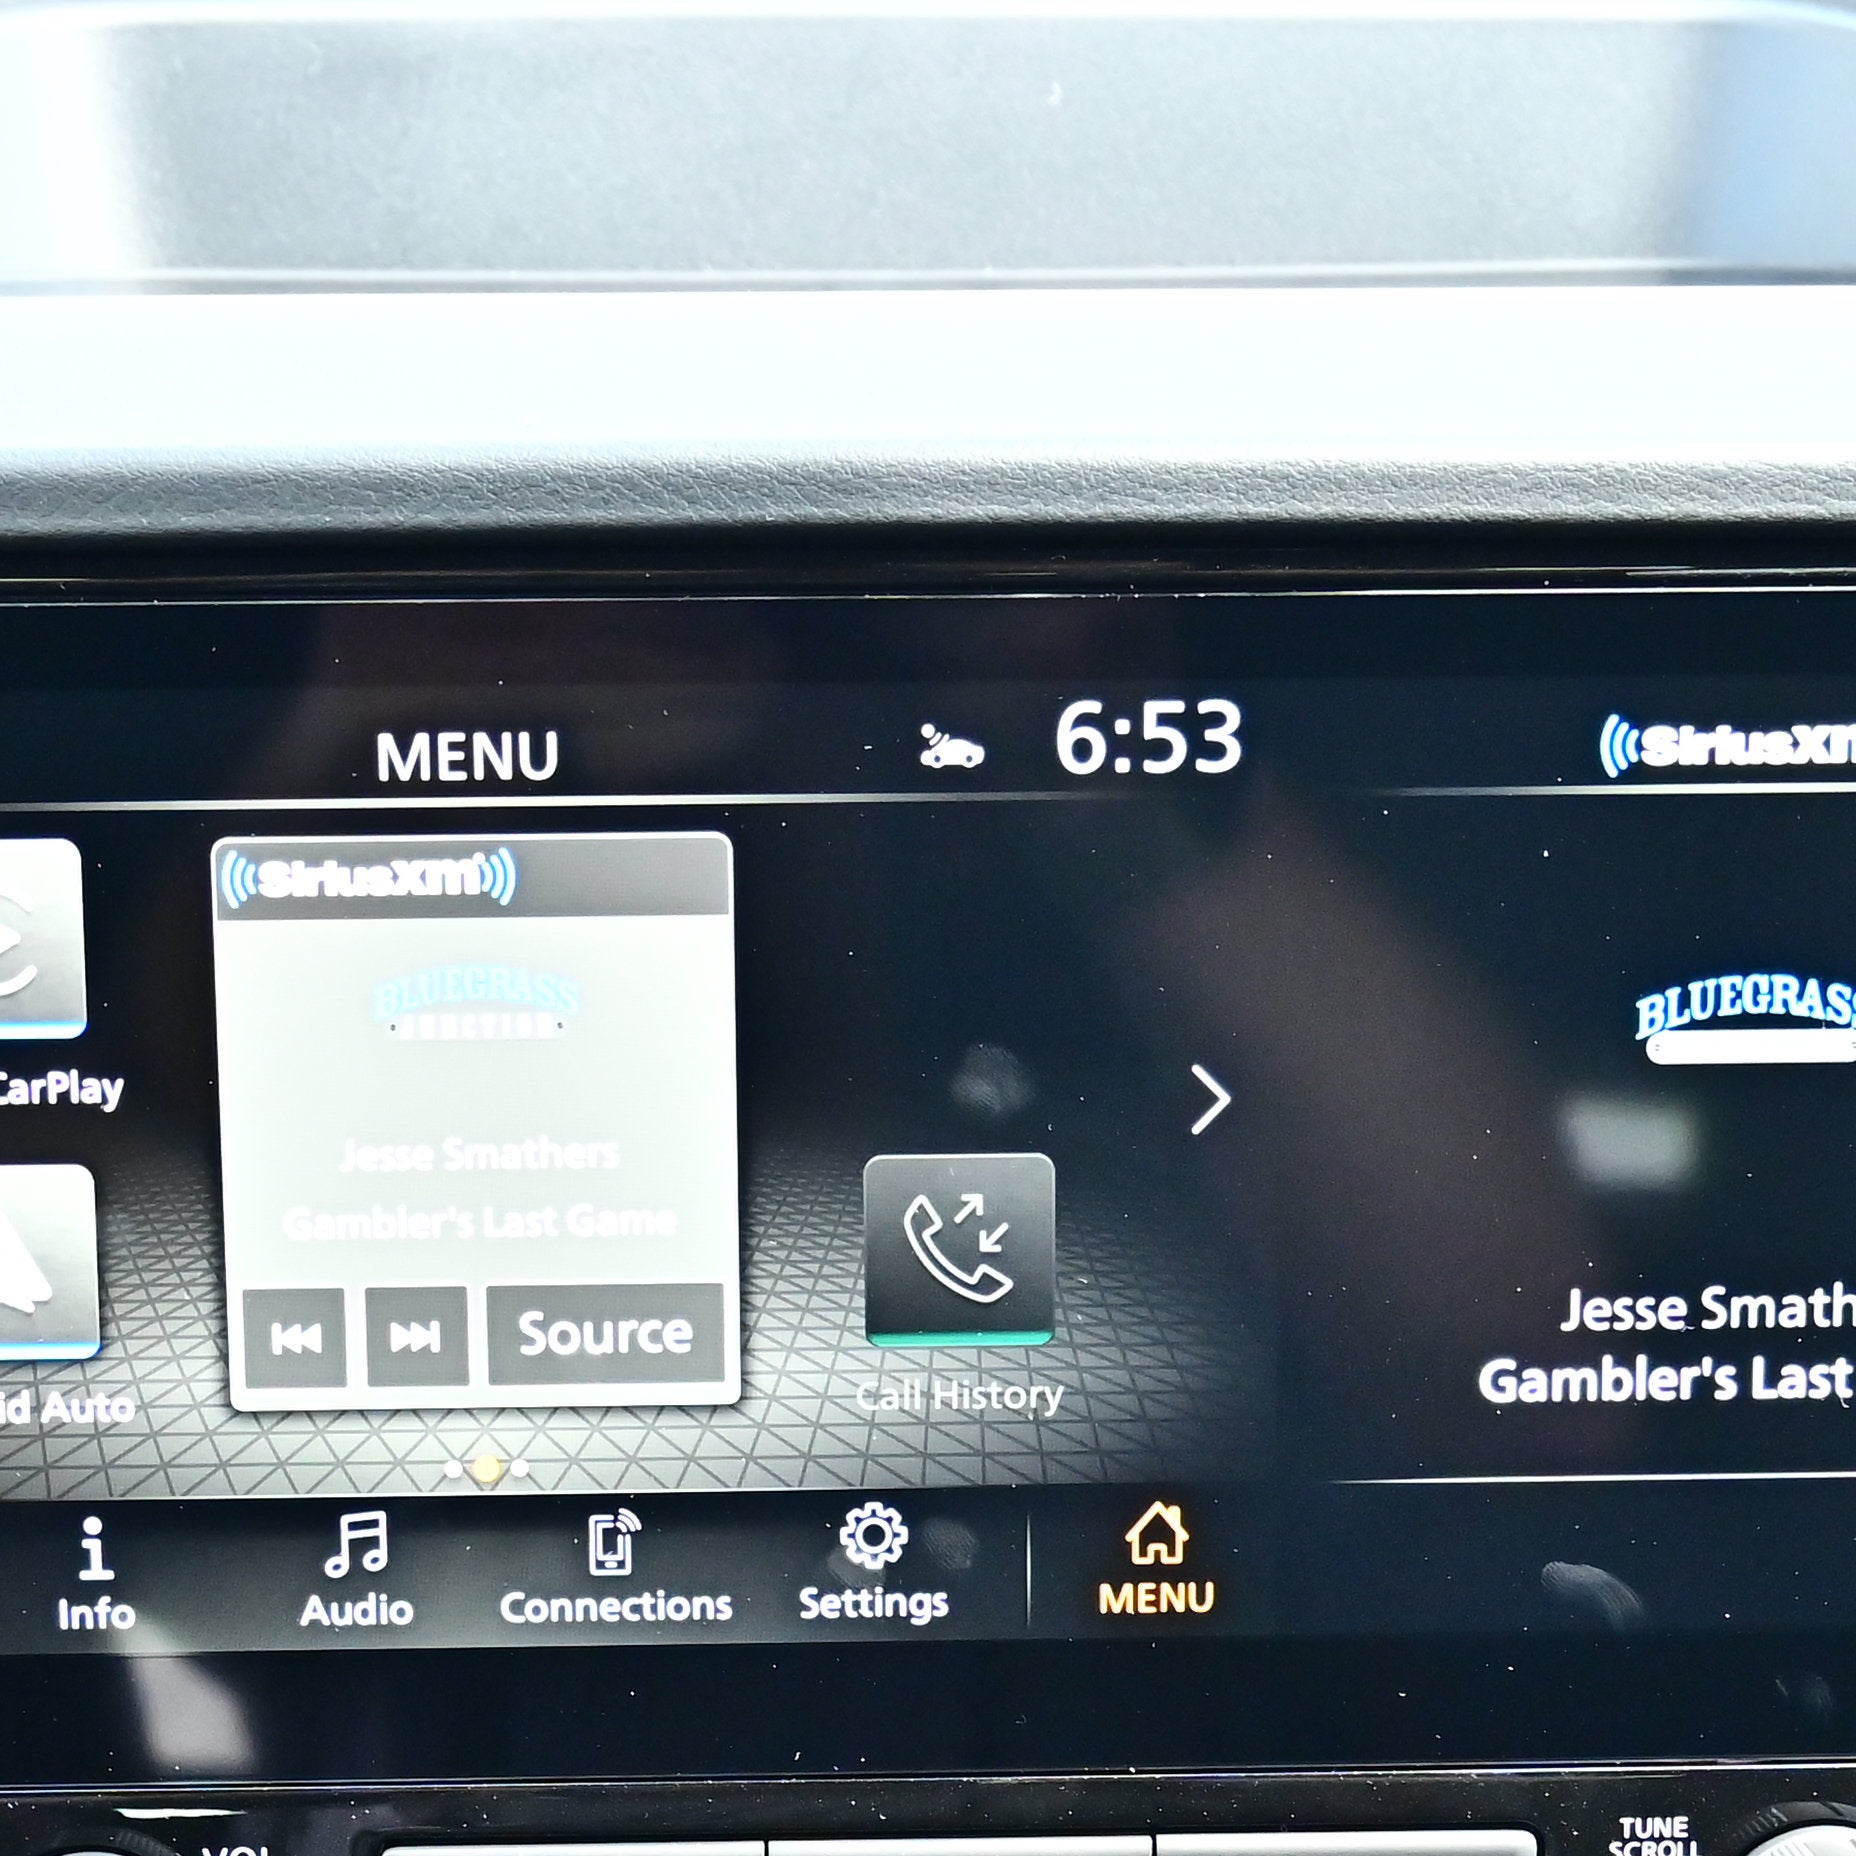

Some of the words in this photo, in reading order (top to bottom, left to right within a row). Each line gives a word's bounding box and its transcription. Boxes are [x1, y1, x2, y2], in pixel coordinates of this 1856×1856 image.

[377, 730, 558, 782] MENU
[1056, 697, 1242, 775] 6:53
[339, 1137, 434, 1175] Jesse
[443, 1133, 621, 1172] Smathers
[282, 1205, 475, 1243] Gambler's
[482, 1205, 560, 1239] Last
[566, 1204, 679, 1239] Game
[1559, 1287, 1693, 1332] Jesse
[518, 1310, 694, 1356] Source
[856, 1379, 921, 1411] Call
[933, 1379, 1065, 1417] History
[1478, 1353, 1739, 1404] Gambler's
[1751, 1354, 1854, 1402] Last
[41, 1389, 136, 1425] Auto
[58, 1595, 136, 1632] Info
[299, 1591, 414, 1627] Audio
[499, 1589, 733, 1624] Connections
[799, 1585, 950, 1626] Settings
[1099, 1581, 1215, 1615] MENU
[1618, 1815, 1689, 1840] TUNE
